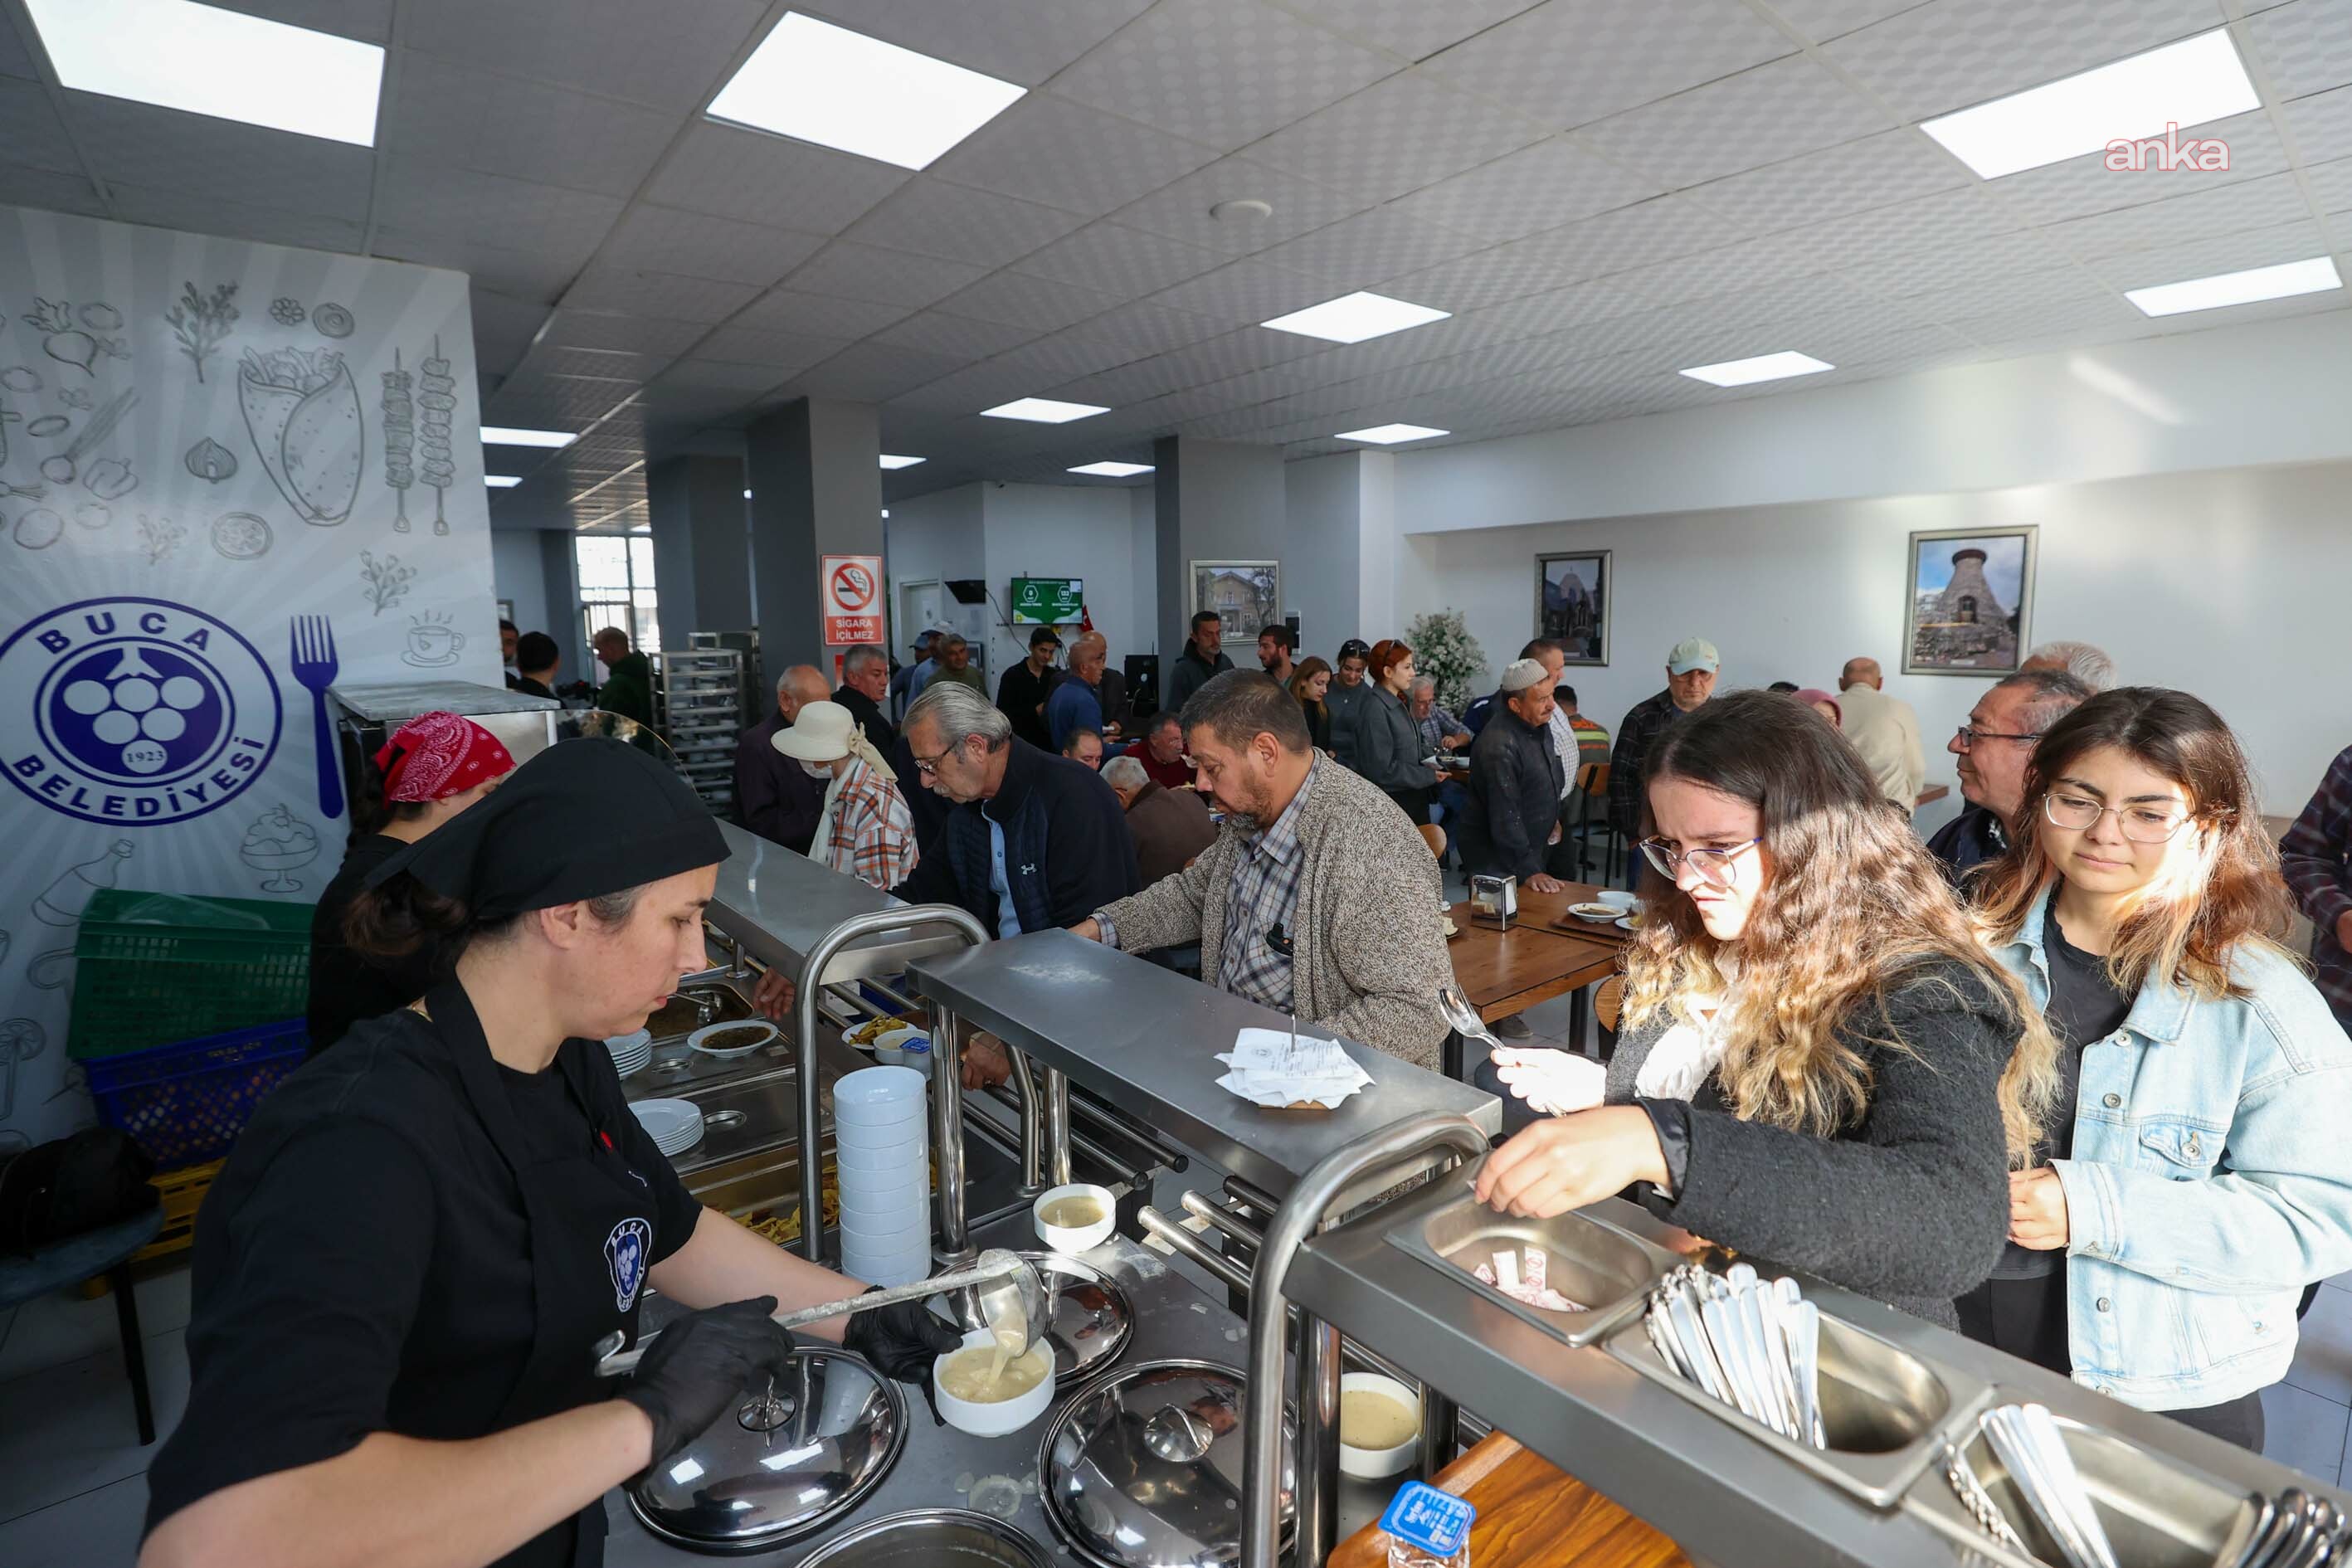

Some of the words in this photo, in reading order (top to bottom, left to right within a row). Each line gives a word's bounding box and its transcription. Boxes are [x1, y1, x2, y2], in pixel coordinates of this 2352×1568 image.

[835, 617, 874, 628] SİGARA
[36, 611, 211, 655] BUCA
[835, 629, 875, 642] İÇİLMEZ
[126, 750, 164, 763] 1923
[12, 735, 265, 818] BELEDİYESİ
